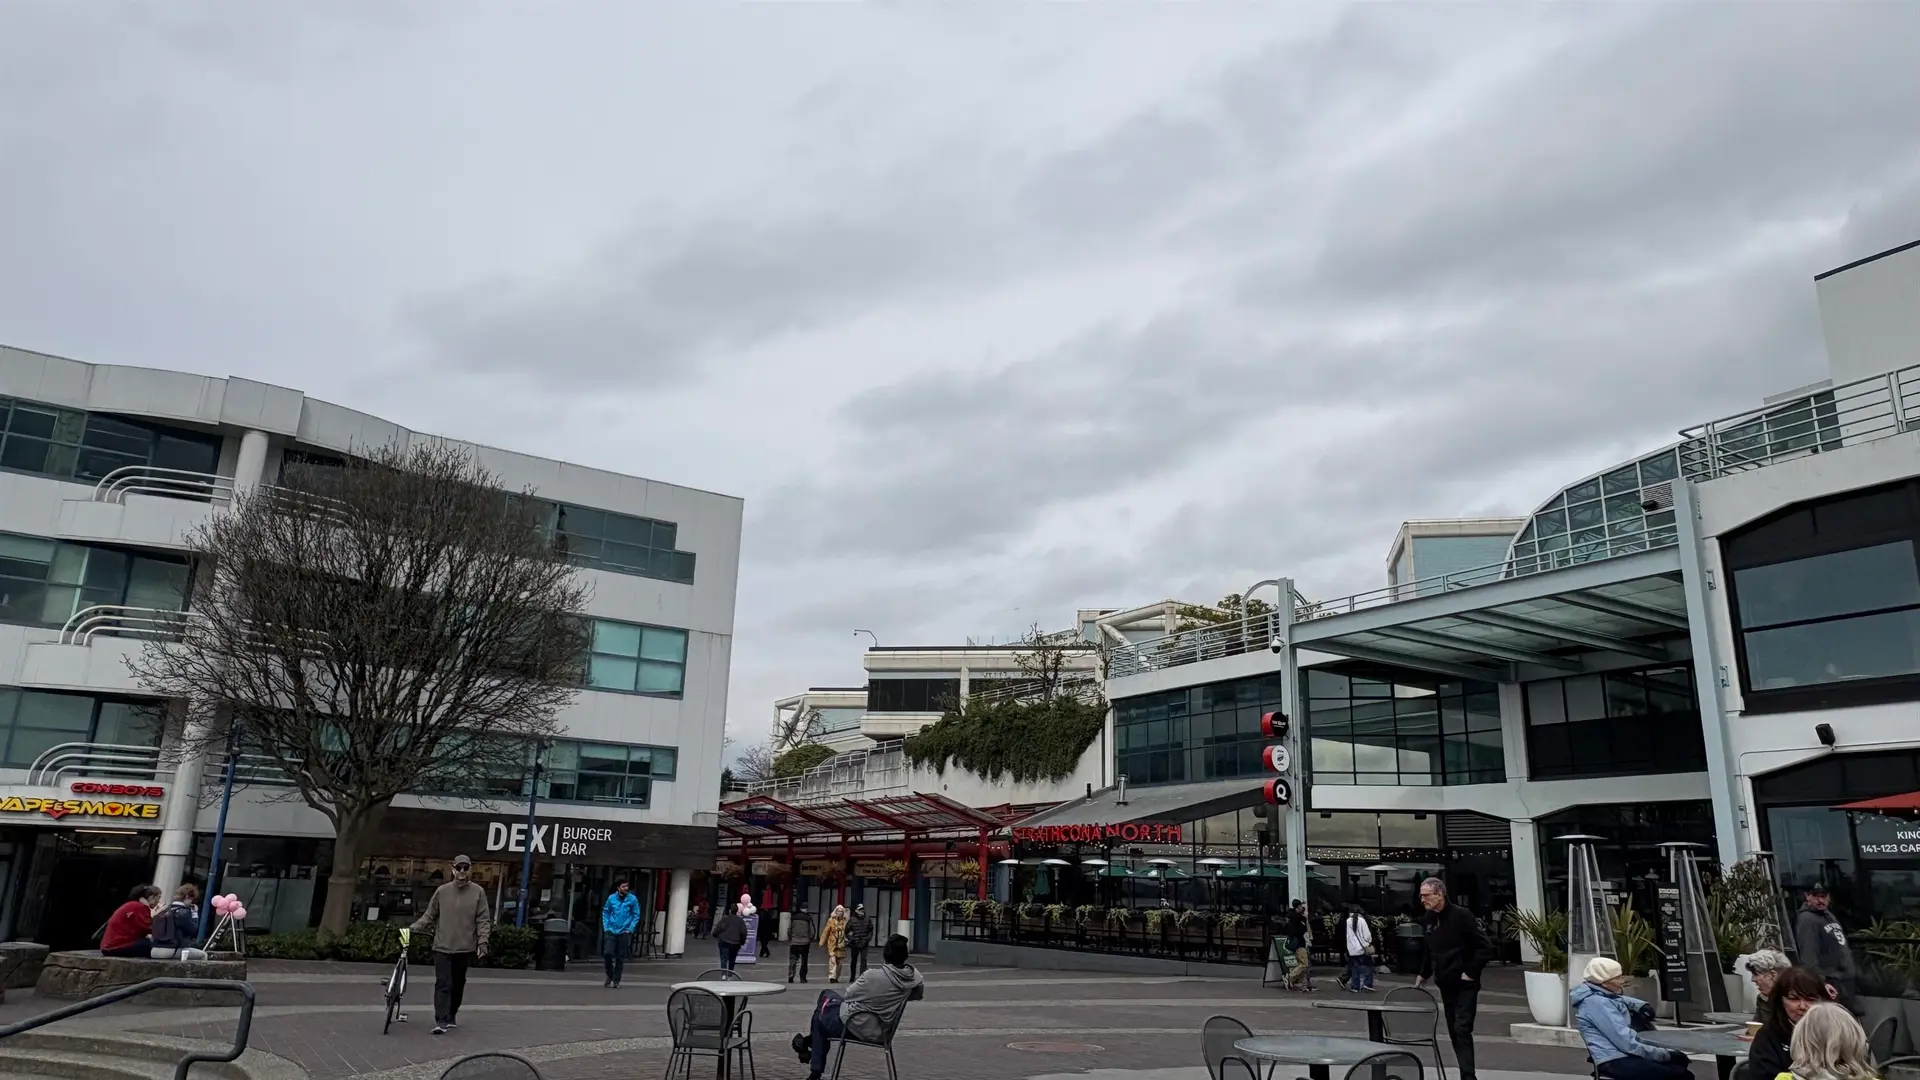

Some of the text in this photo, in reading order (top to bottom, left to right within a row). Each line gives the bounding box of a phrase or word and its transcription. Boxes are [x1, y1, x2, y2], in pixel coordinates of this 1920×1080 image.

[70, 782, 164, 797] COWBOYS
[1276, 784, 1287, 800] Q
[62, 800, 160, 819] SMOKE
[486, 822, 612, 853] DEX BURGER
[1105, 823, 1182, 843] NORTH
[561, 842, 587, 856] BAR
[1860, 844, 1898, 853] 141-123
